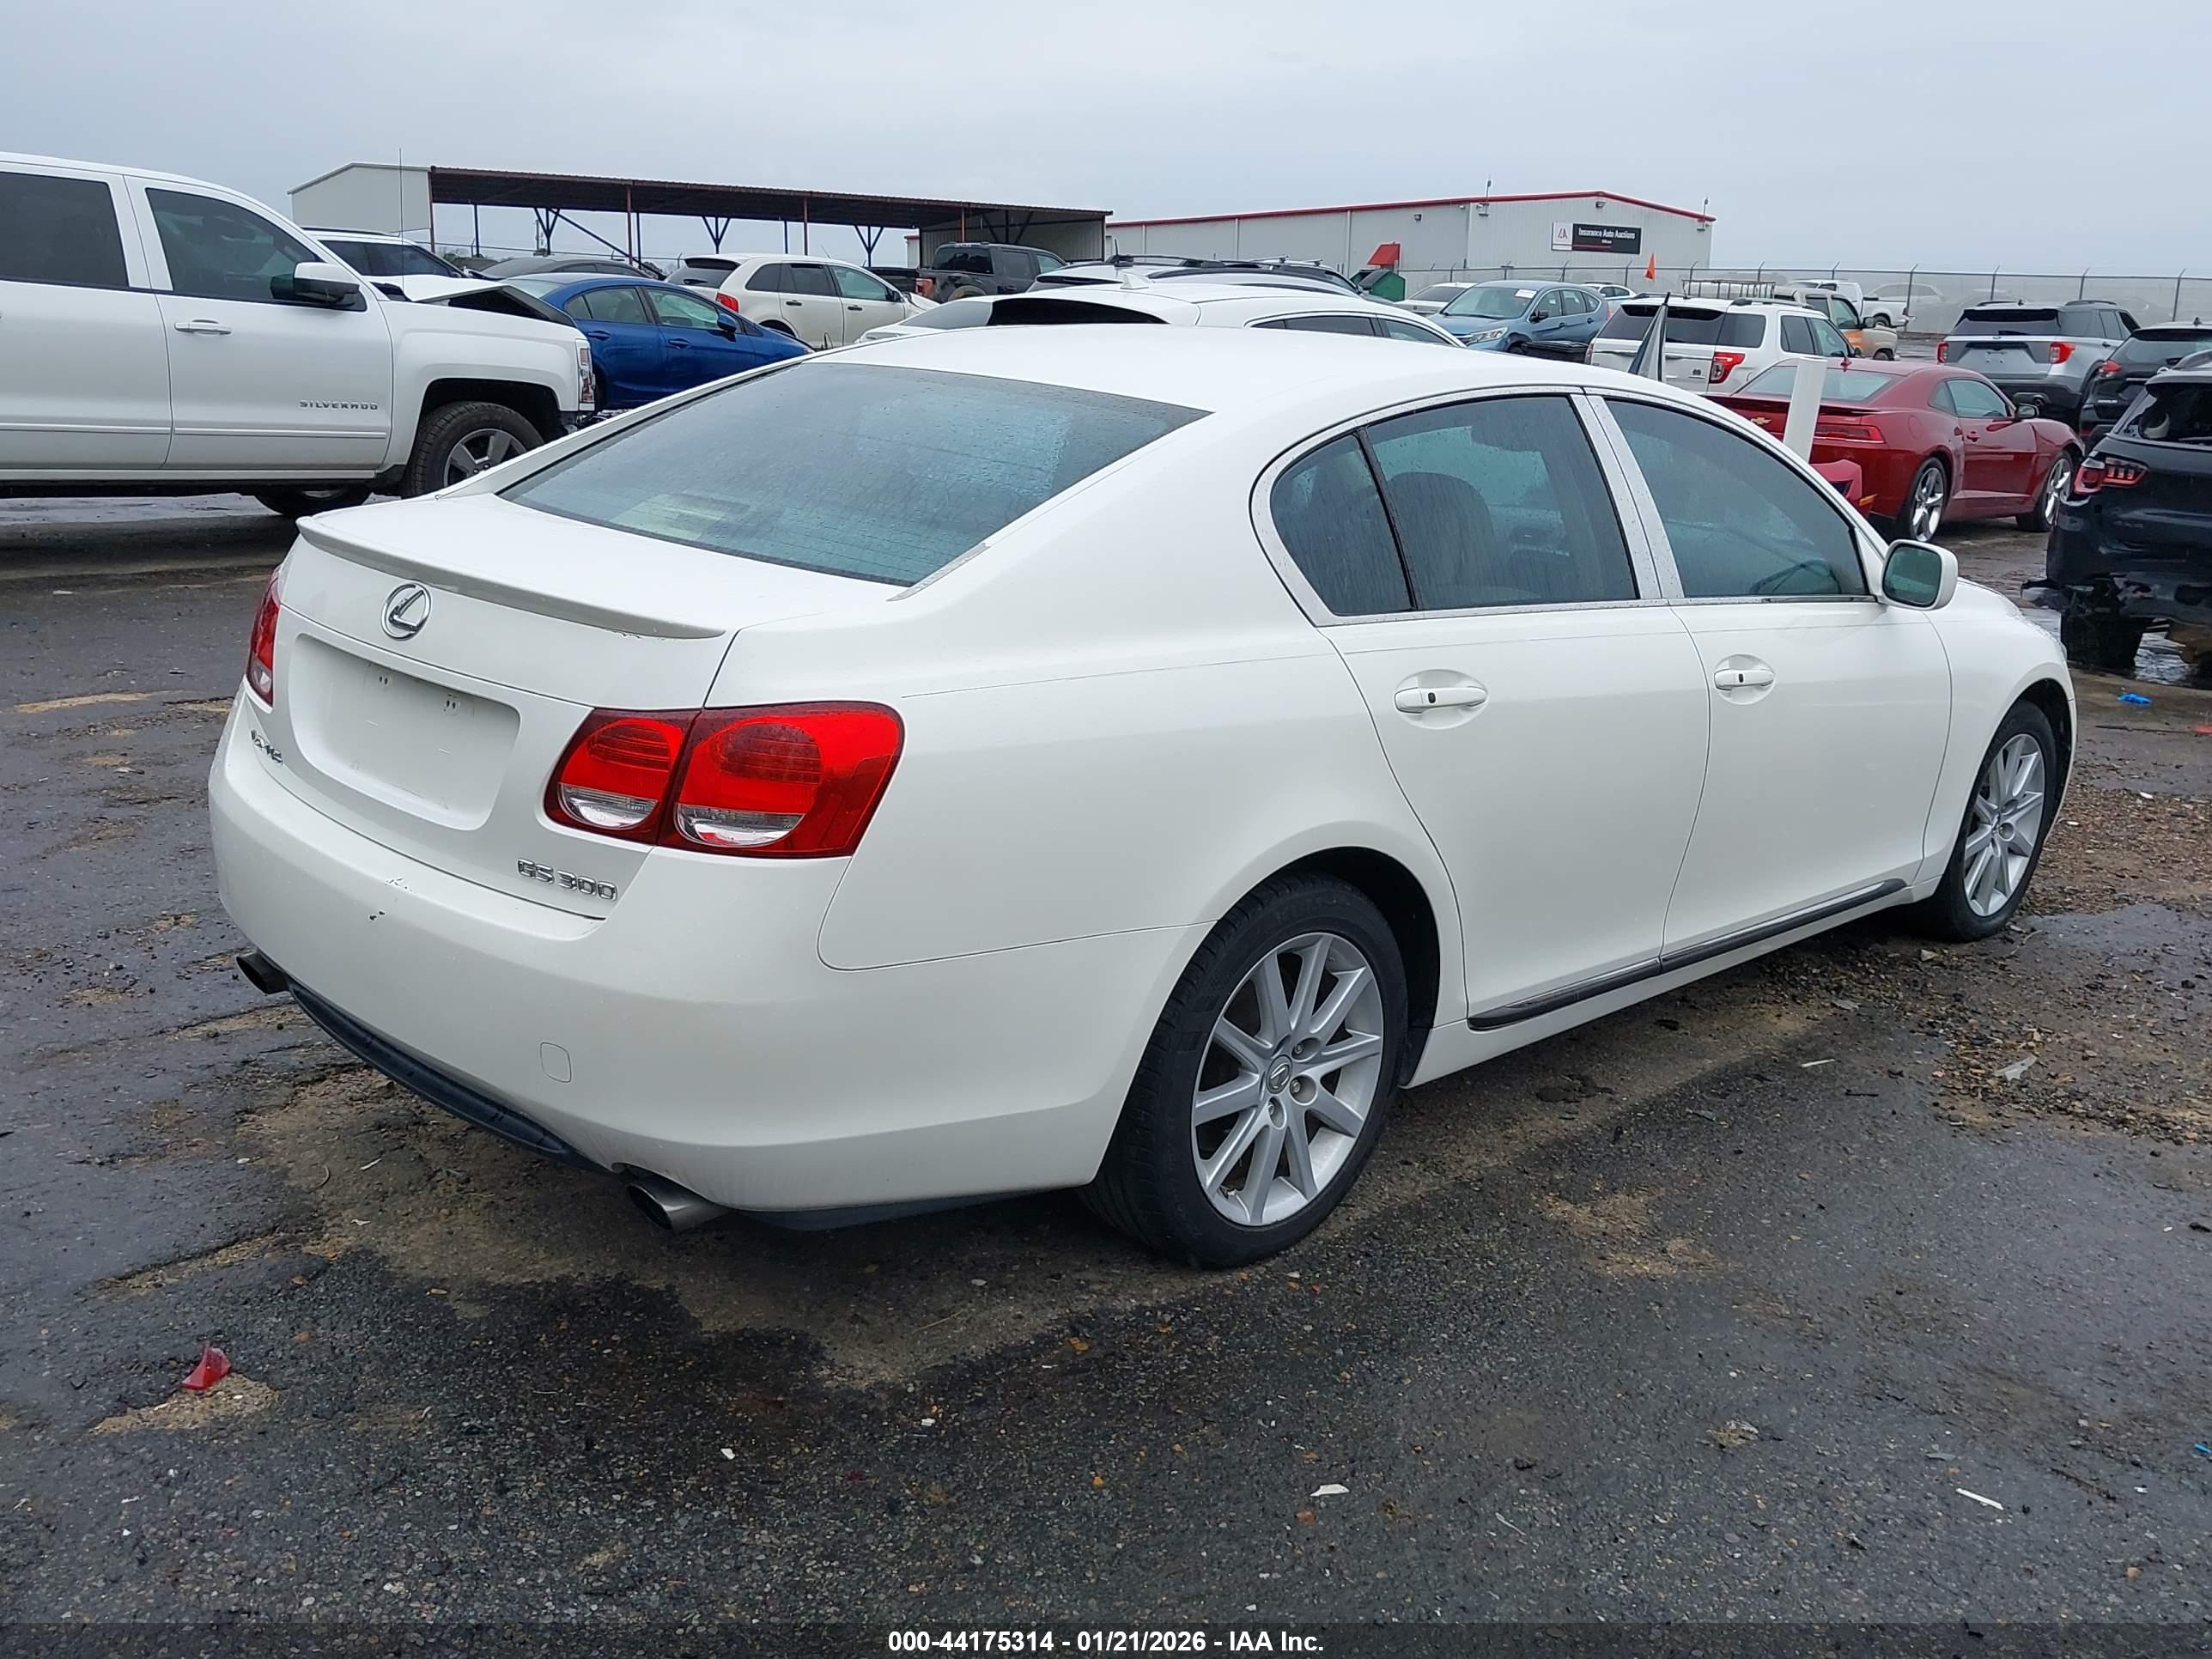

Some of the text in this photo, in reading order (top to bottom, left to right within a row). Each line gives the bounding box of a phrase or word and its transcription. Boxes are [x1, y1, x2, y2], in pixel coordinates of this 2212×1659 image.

[299, 399, 379, 411] SILVERADO
[516, 858, 618, 902] GS 300
